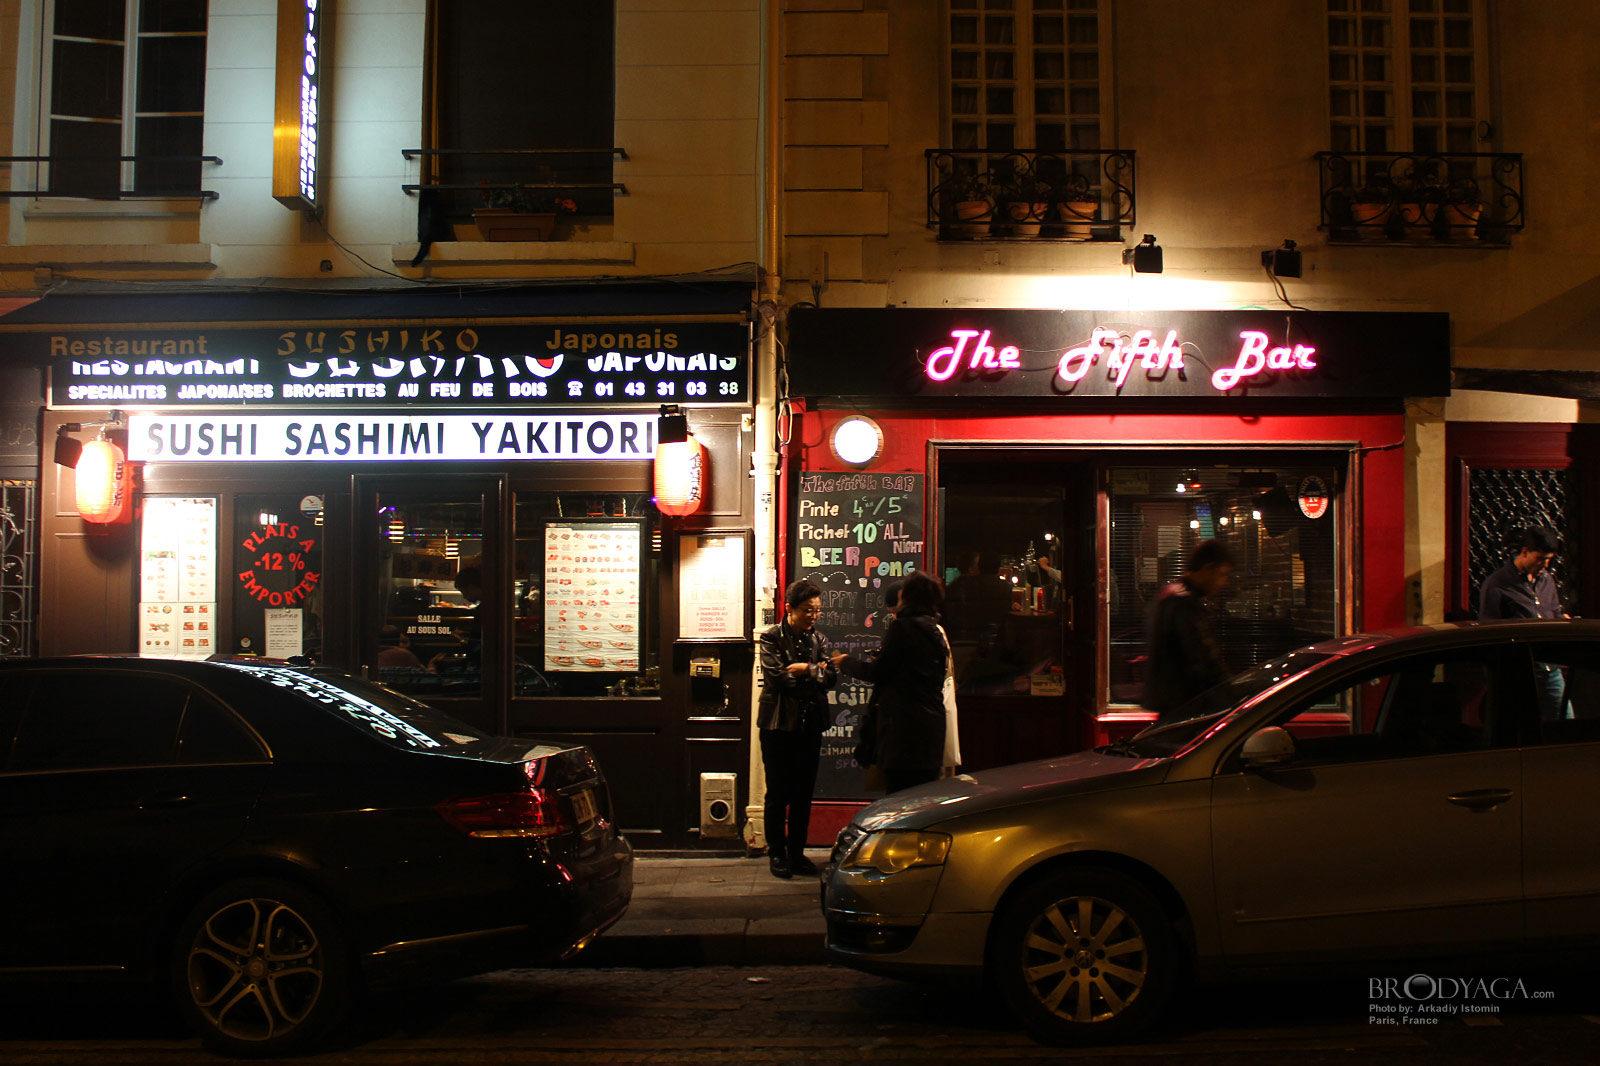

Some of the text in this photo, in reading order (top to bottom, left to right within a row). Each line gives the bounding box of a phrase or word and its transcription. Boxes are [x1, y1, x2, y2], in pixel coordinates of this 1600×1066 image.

[307, 85, 317, 200] JAPONAIS
[50, 335, 208, 356] Restaurant
[277, 328, 479, 356] SUSHIKO
[546, 328, 679, 353] Japonais
[926, 328, 1317, 391] The Fifth Bar
[68, 381, 739, 400] SPECIALITES JAPONAISES BROCHETTES AU FEU DE BOIS 01 43 31 03 38
[146, 421, 654, 456] SUSHI SASHIMI YAKITORI
[800, 474, 915, 493] The fifth BAR
[800, 500, 839, 517] Pinte
[242, 522, 315, 553] PLATS A
[799, 523, 850, 540] Pichet
[883, 522, 910, 540] ALL
[254, 553, 305, 571] -12 %
[800, 546, 861, 568] BEER
[238, 570, 321, 606] EMPORTER
[821, 590, 858, 609] APPY
[418, 615, 442, 623] SALLE
[406, 626, 452, 635] AU SOUS SOL
[825, 638, 882, 653] hampions
